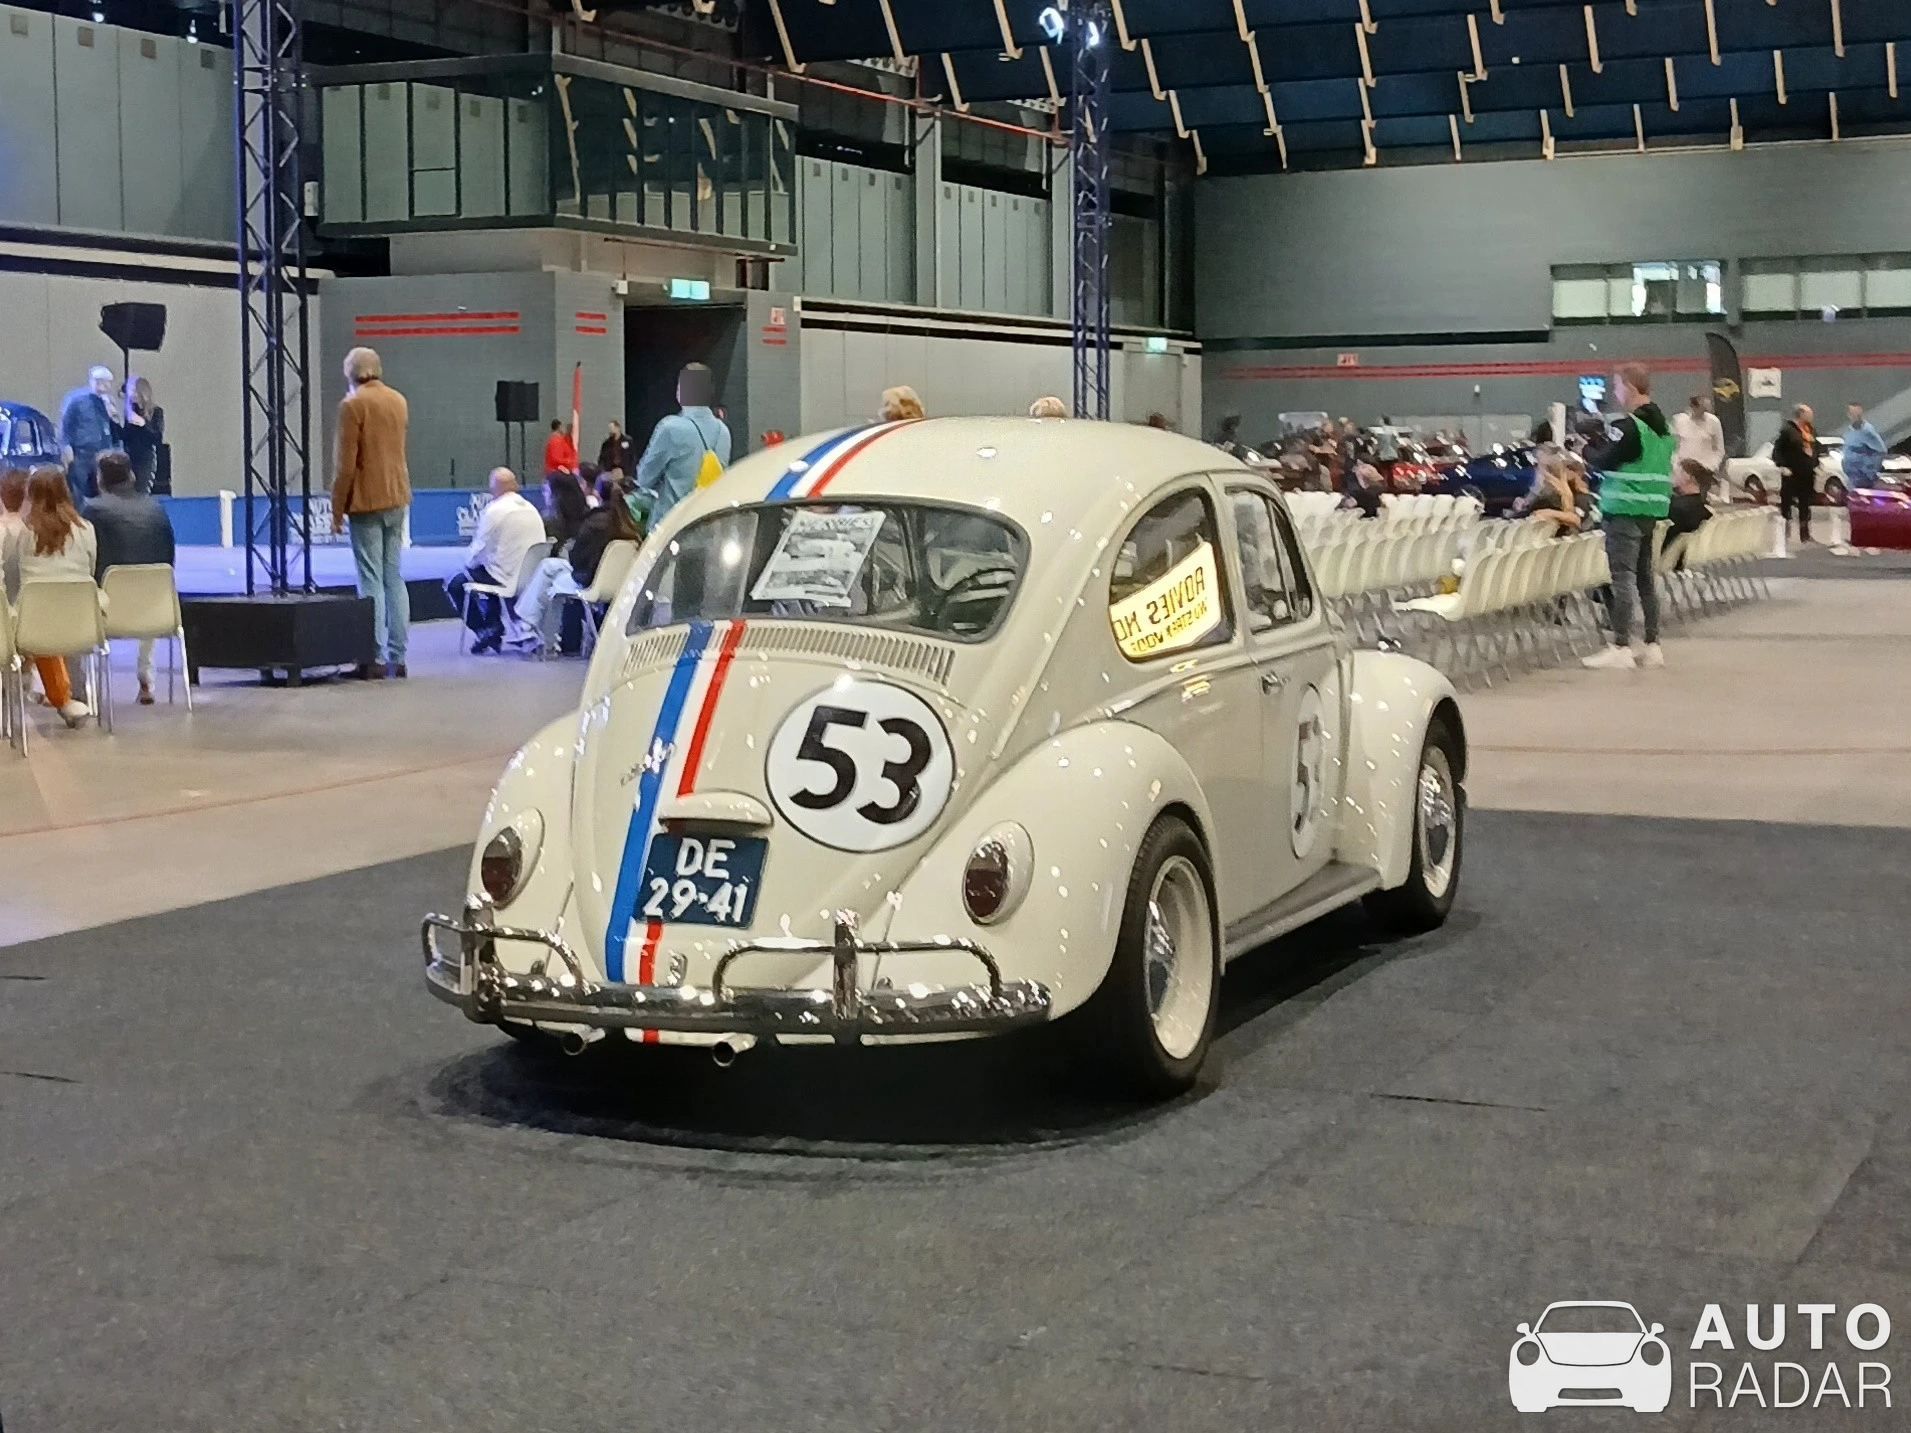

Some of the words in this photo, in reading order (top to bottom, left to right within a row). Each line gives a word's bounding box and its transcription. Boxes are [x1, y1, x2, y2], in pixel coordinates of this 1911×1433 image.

[789, 705, 932, 824] 53
[675, 837, 736, 880] DE
[641, 876, 748, 923] 29-41
